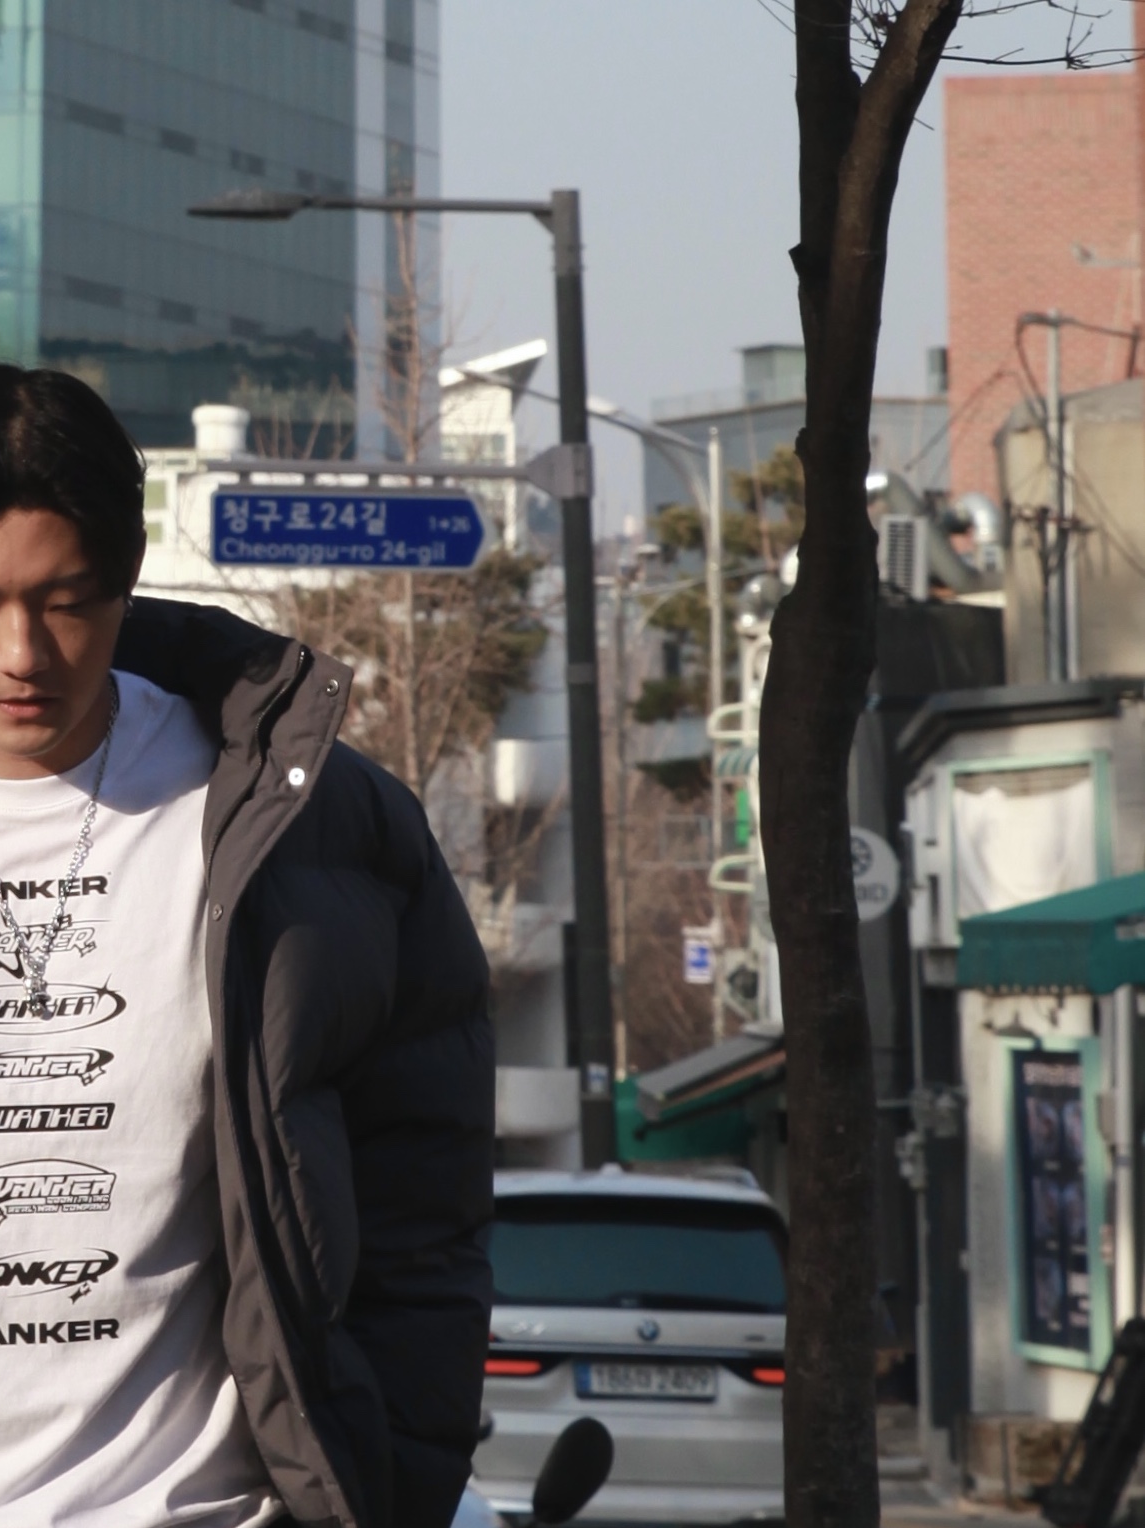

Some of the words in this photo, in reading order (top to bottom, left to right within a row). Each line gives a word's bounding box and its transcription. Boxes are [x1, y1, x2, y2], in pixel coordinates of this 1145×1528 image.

[222, 499, 387, 536] 청구로24길
[219, 537, 375, 565] Cheonggu-ro
[380, 540, 447, 566] 24-gil
